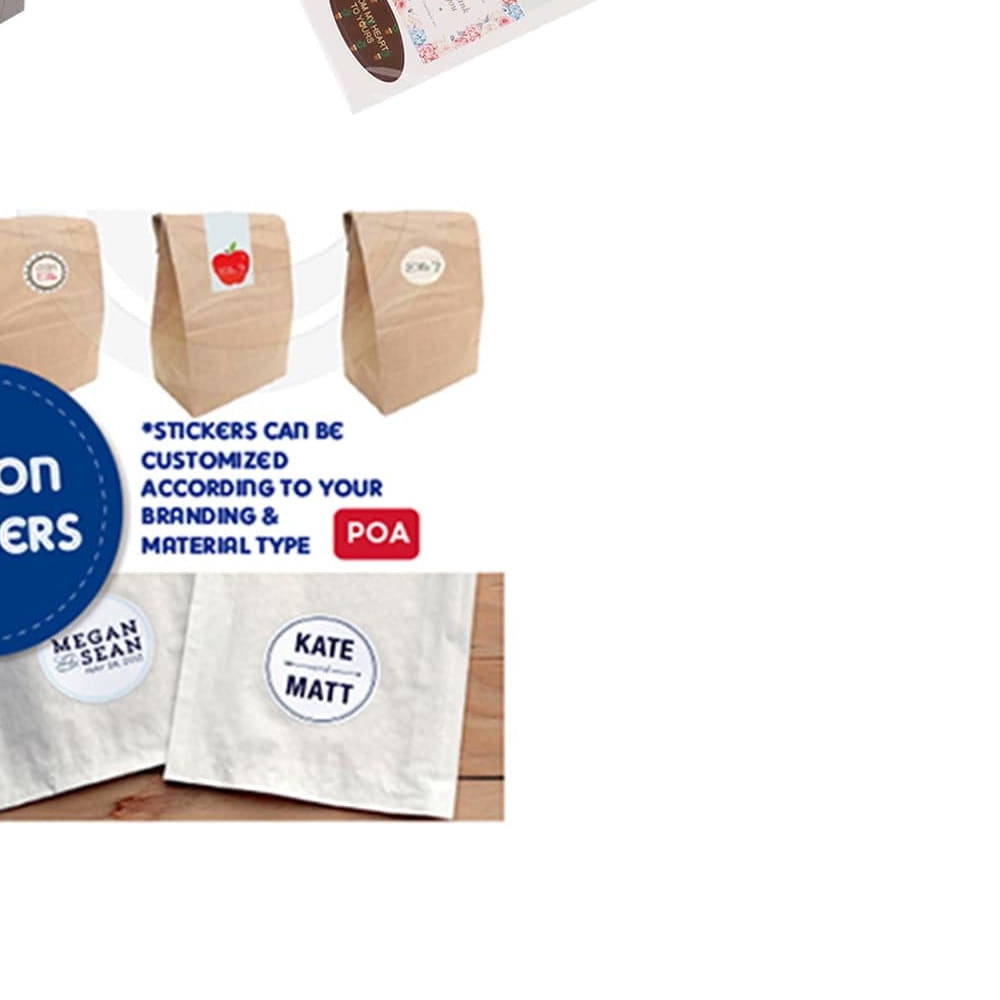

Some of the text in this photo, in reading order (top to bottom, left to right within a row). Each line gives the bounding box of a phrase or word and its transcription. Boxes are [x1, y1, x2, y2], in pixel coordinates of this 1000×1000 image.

[350, 2, 375, 44] TO YOURS
[370, 24, 389, 52] HEART
[263, 421, 309, 440] CAN
[315, 421, 344, 440] BE
[141, 451, 289, 470] CUSTOMIZED
[141, 478, 383, 498] ACCORDING TO YOUR
[141, 506, 279, 526] BRANDING &
[347, 521, 411, 544] POA
[141, 536, 311, 555] MATERIAL TYPE
[51, 618, 138, 655] MEGAN
[294, 631, 355, 662] KATE
[80, 635, 143, 666] SEAN
[285, 673, 355, 706] MATT
